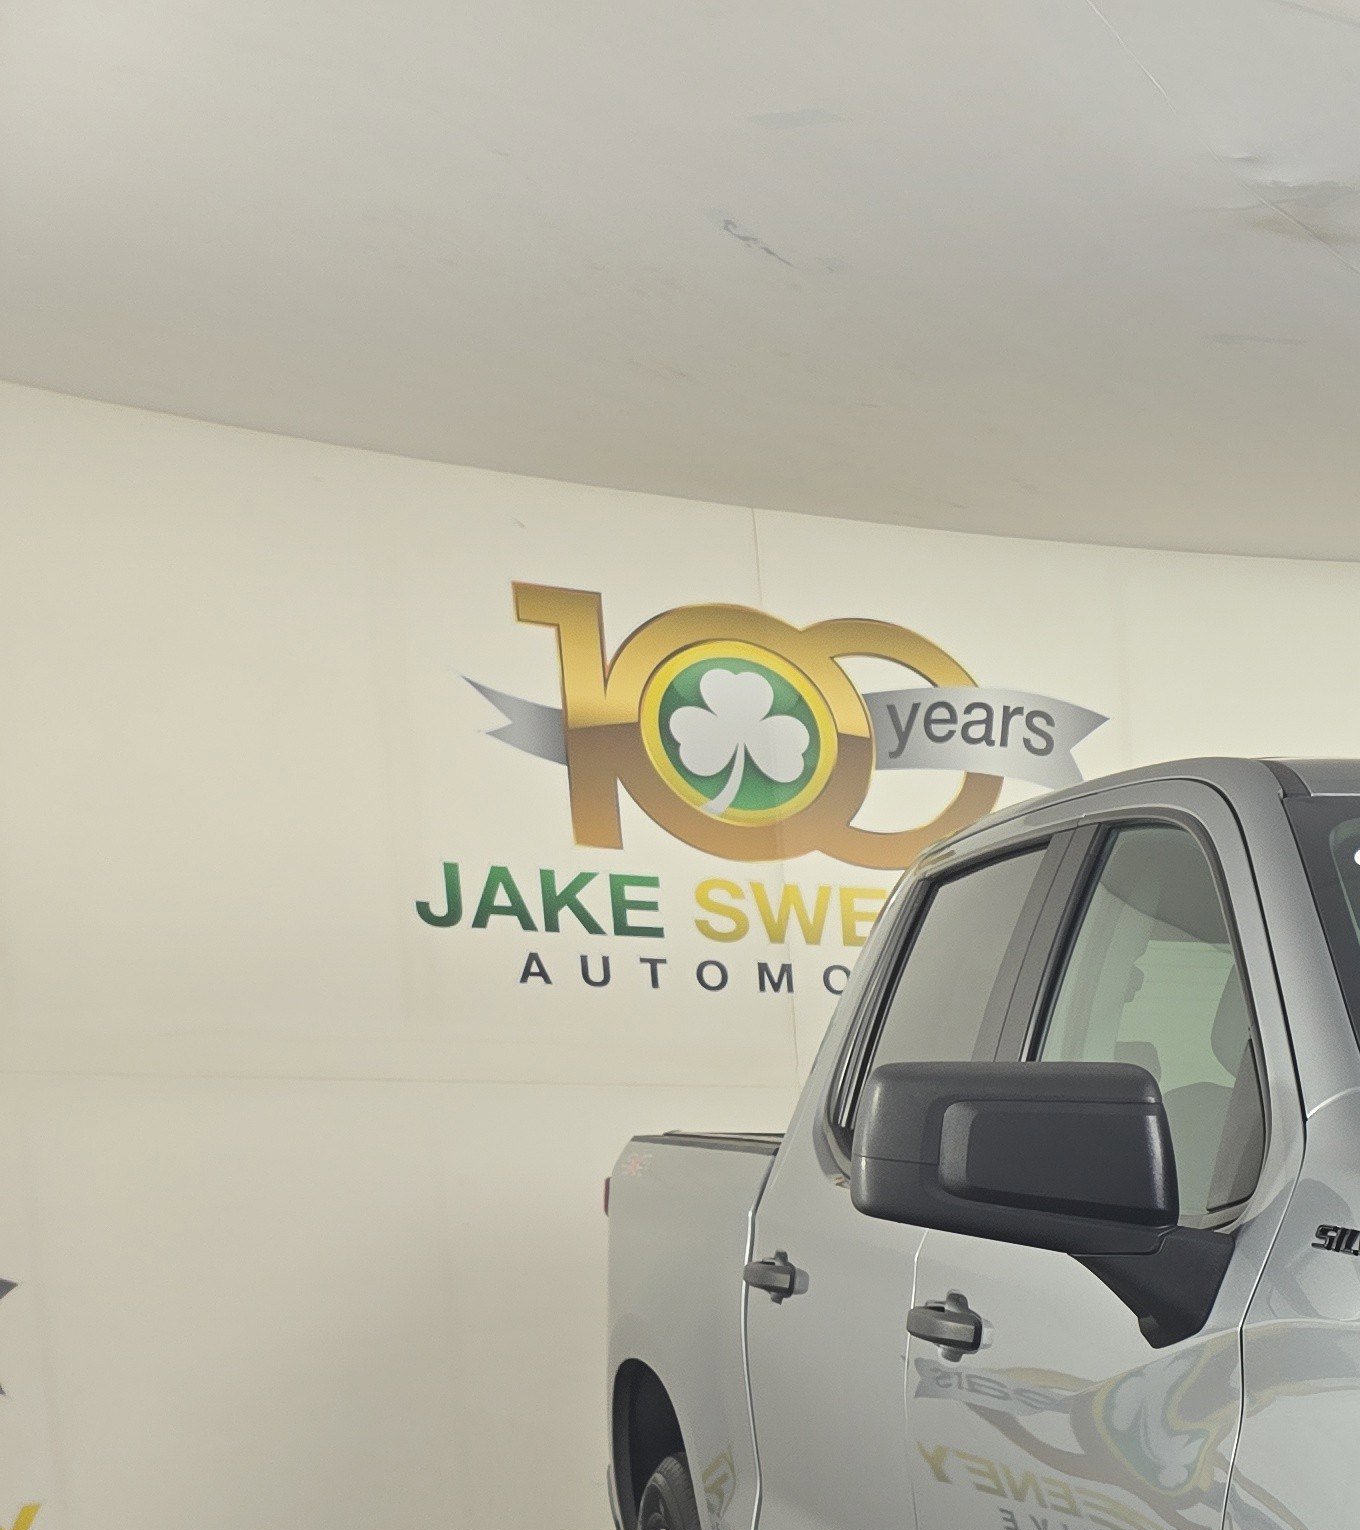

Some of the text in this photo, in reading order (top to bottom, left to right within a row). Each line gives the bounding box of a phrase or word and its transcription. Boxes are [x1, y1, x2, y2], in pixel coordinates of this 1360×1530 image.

[512, 581, 1056, 870] 100 years
[416, 862, 665, 938] JAKE
